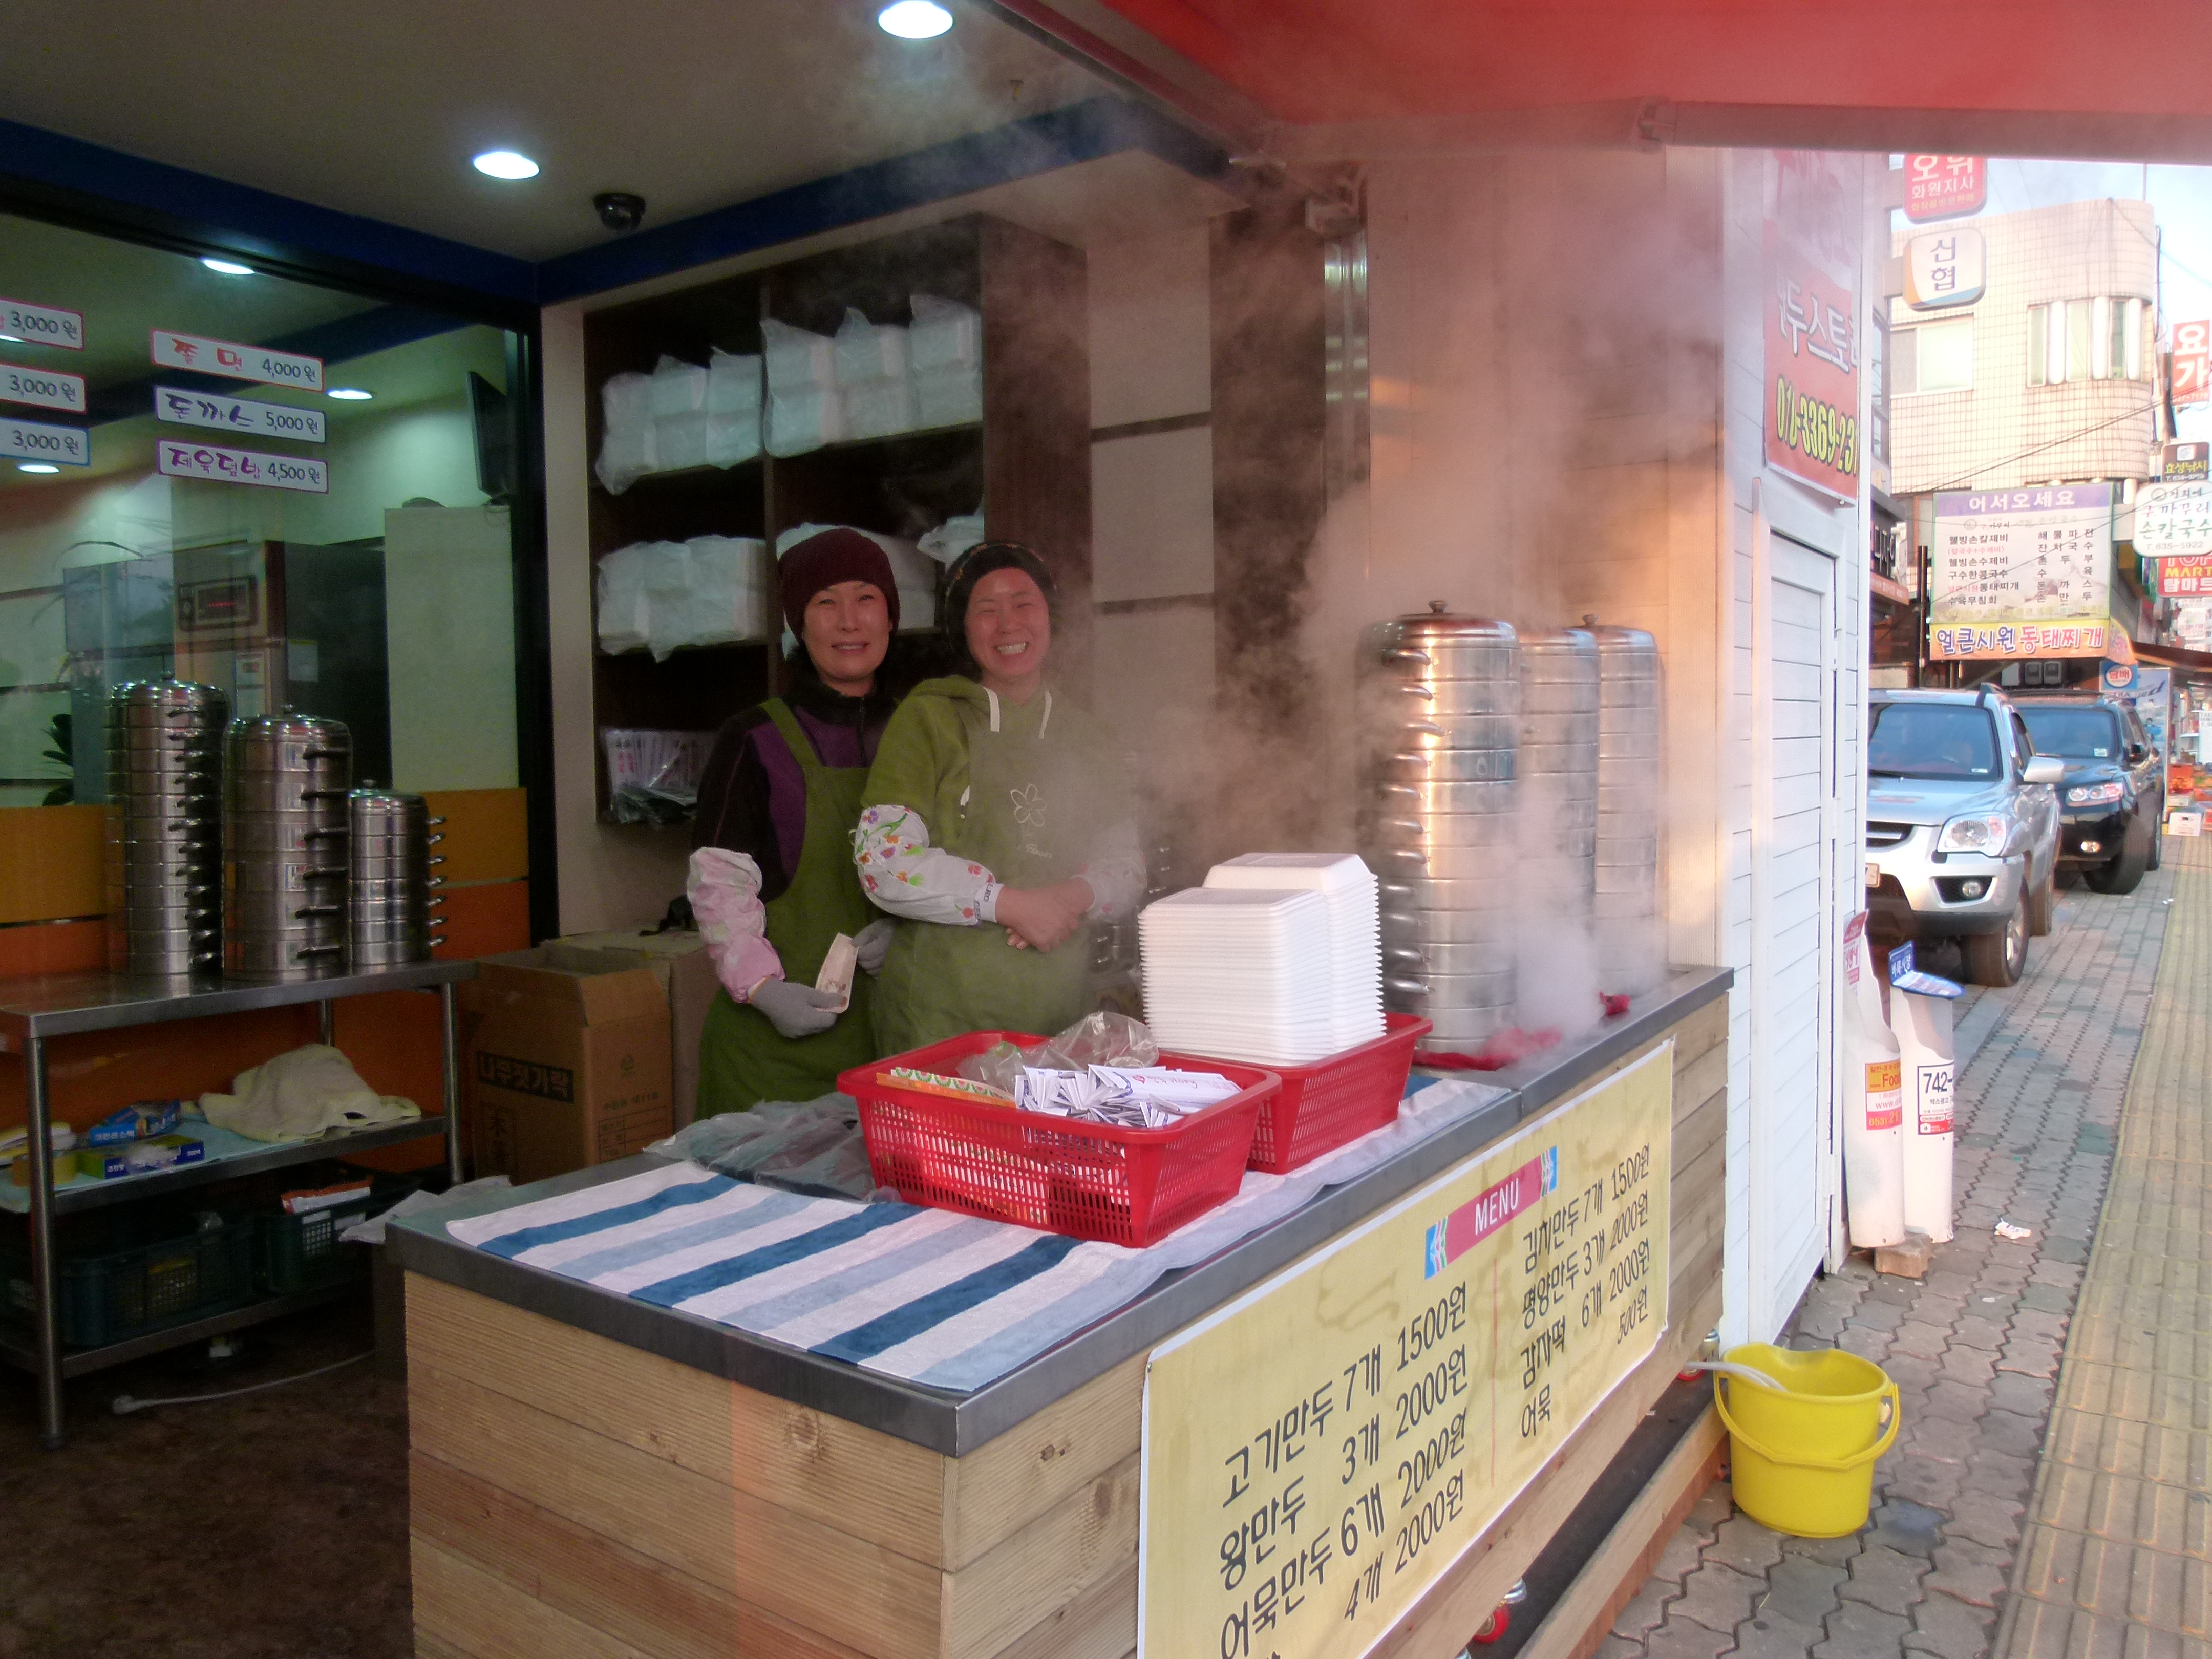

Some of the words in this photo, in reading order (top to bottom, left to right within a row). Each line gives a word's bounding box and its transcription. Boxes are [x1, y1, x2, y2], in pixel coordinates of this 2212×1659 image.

[1930, 237, 1955, 292] 신협
[168, 447, 261, 480] 제육덮밥
[1969, 490, 2075, 512] 어서오세요
[2139, 518, 2212, 539] 손칼국수
[1475, 1178, 1520, 1236] MENU
[1522, 1250, 1579, 1330] 평양만두
[1583, 1228, 1605, 1277] 3개
[1610, 1189, 1648, 1251] 2000원
[1523, 1197, 1579, 1275] 김치만두
[1584, 1178, 1603, 1223] 7개
[1611, 1142, 1649, 1201] 1500원
[1520, 1315, 1565, 1390] 감자떡
[1581, 1280, 1602, 1328] 6개
[1609, 1237, 1649, 1302] 2000원
[1521, 1383, 1551, 1438] 어묵
[1617, 1285, 1648, 1346] 500원
[1222, 1380, 1334, 1508] 고기만두
[1343, 1343, 1381, 1412] 7개
[1396, 1281, 1466, 1372] 1500원
[1220, 1475, 1306, 1591] 왕만두
[1341, 1413, 1380, 1486] 3개
[1395, 1343, 1467, 1440] 2000원
[1220, 1526, 1332, 1659] 어묵만두
[1340, 1482, 1385, 1558] 6개
[1397, 1407, 1467, 1509] 2000원
[1344, 1551, 1384, 1621] 4개
[1394, 1468, 1463, 1575] 2000원
